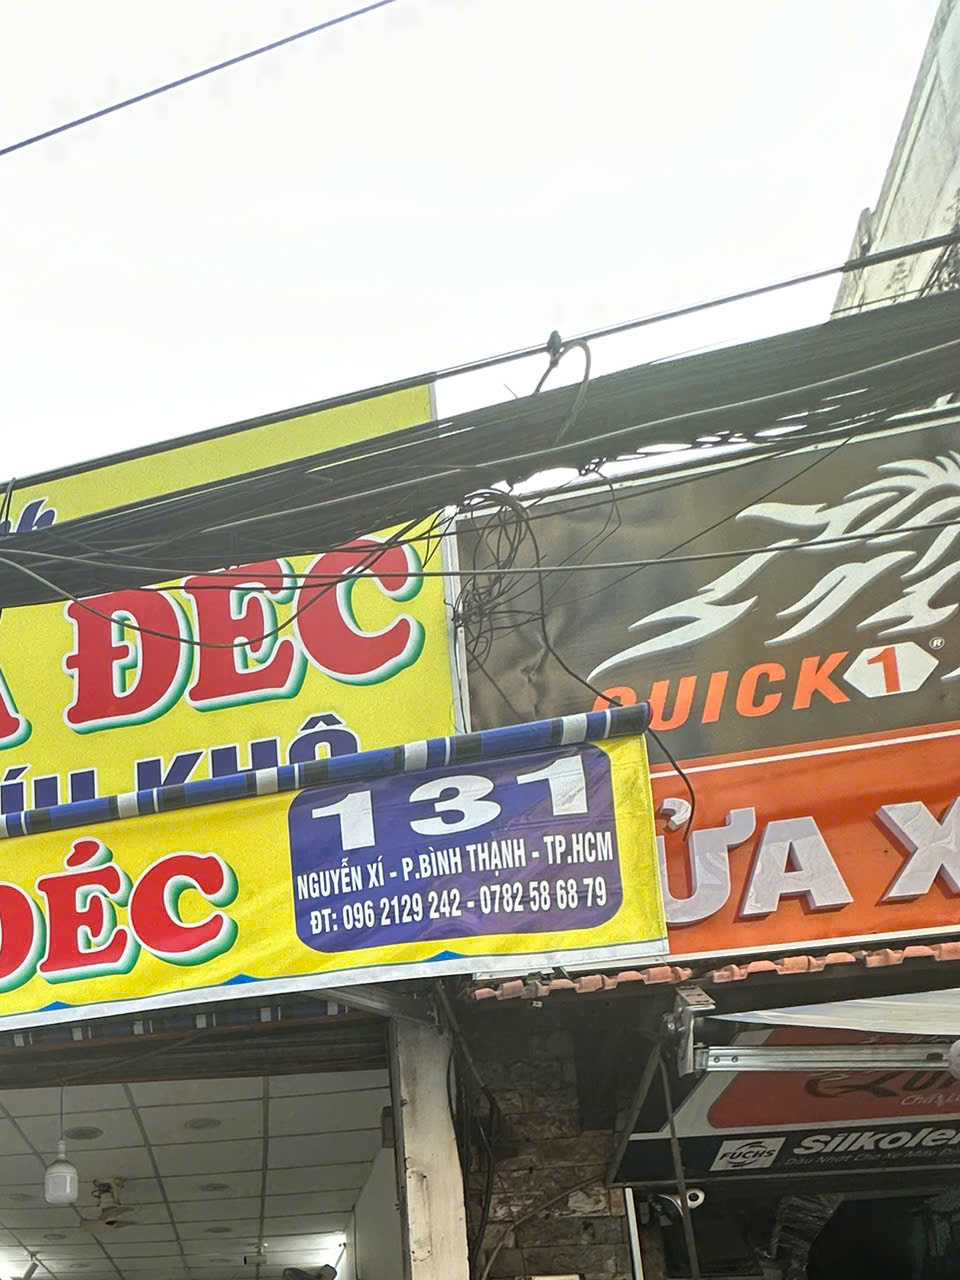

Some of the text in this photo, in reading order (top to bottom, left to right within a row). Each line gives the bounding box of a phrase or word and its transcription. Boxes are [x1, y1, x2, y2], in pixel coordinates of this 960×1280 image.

[311, 754, 589, 852] 131
[297, 857, 363, 900] NGUYỄN
[367, 855, 385, 888] XÍ
[469, 837, 527, 877] THẠNH
[543, 831, 614, 865] TP.HCM
[310, 906, 338, 935] ĐT:
[342, 902, 375, 932] 096
[380, 896, 424, 927] 2129
[428, 889, 461, 921] 242
[480, 884, 524, 915] 0782
[529, 880, 551, 912] 58
[556, 878, 579, 910] 68
[583, 876, 607, 907] 79
[719, 1149, 777, 1162] FUCHS
